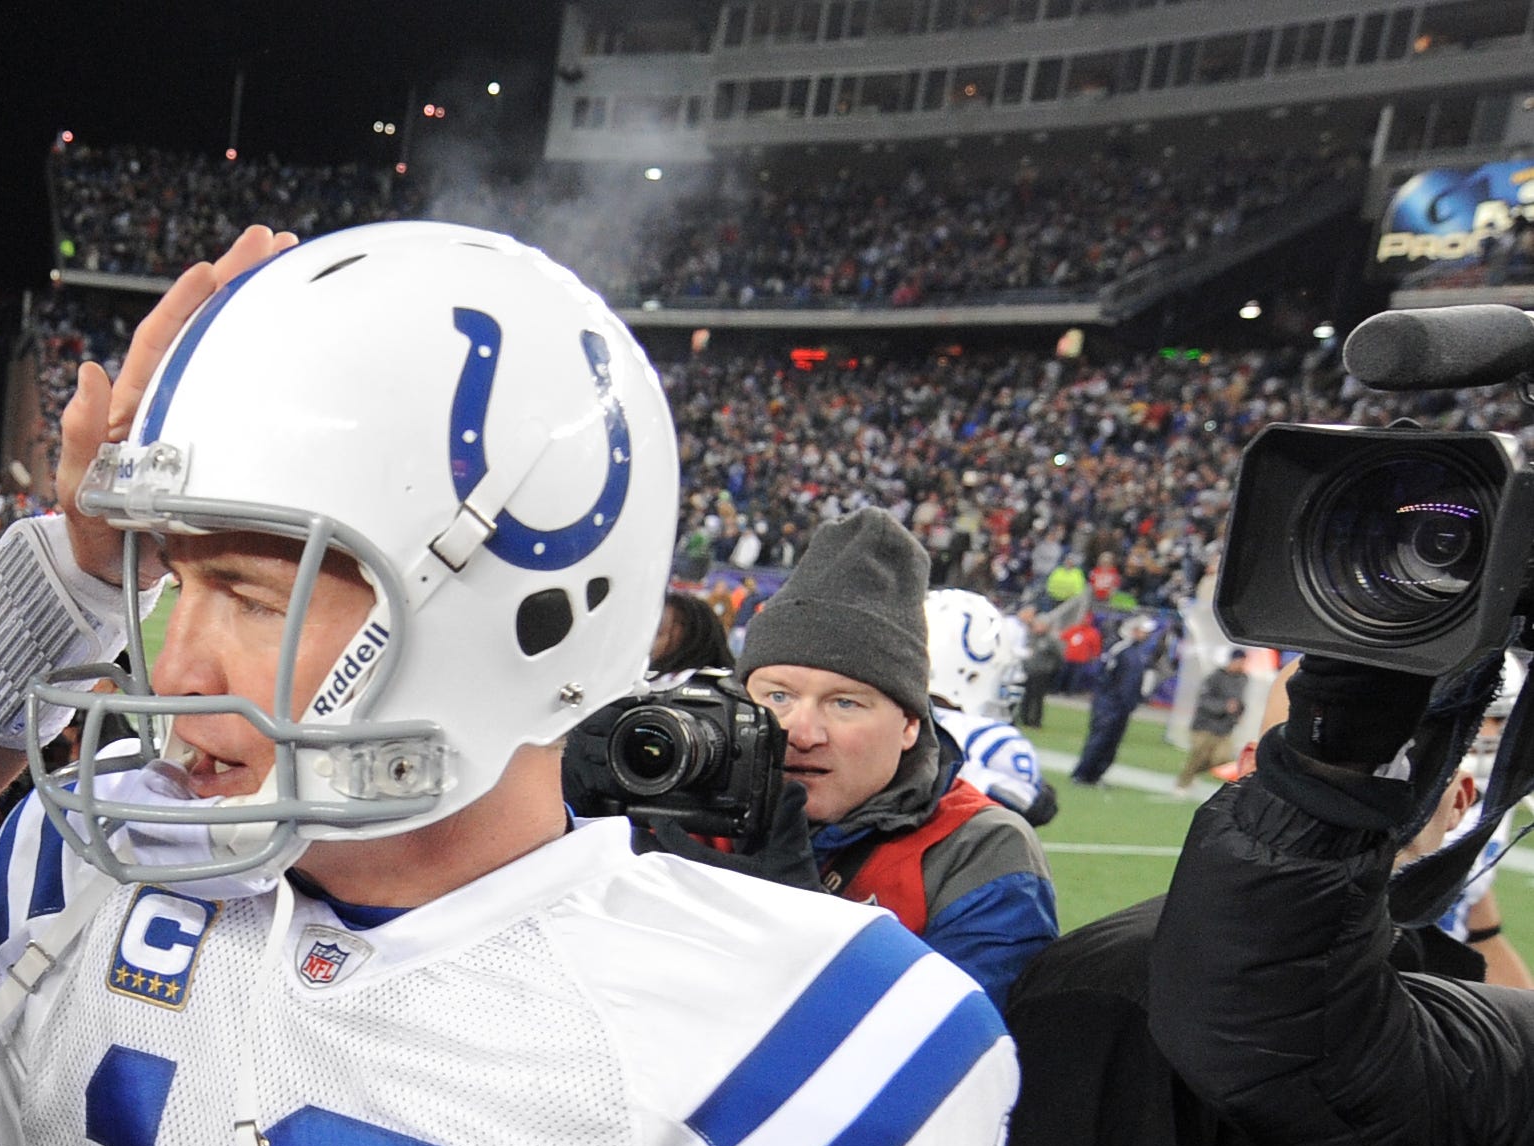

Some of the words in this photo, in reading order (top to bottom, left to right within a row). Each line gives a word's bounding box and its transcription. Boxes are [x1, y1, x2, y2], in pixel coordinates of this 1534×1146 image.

[313, 622, 390, 716] Riddell
[121, 893, 207, 976] C
[303, 955, 334, 979] NFL
